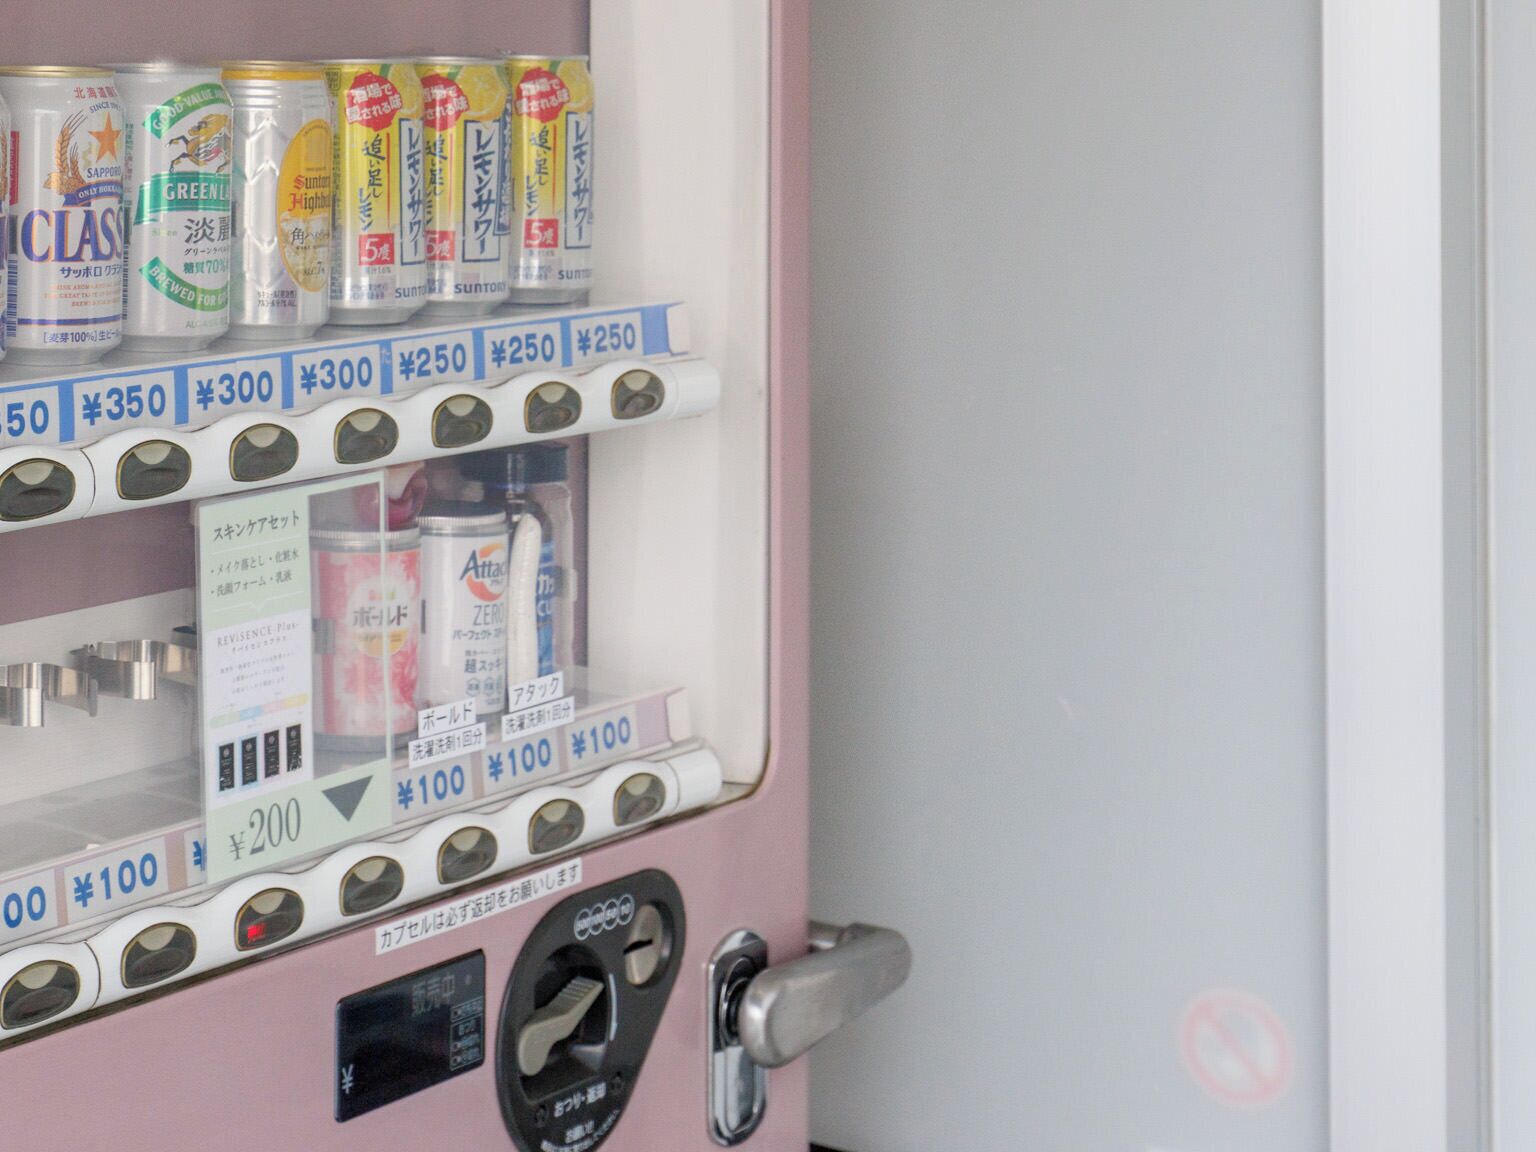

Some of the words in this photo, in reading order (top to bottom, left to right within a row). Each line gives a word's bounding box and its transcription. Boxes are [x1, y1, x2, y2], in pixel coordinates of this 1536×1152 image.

[184, 89, 214, 106] VALUE
[351, 82, 393, 105] 酒場で
[515, 88, 570, 114] 愛される味
[520, 77, 561, 97] 酒場で
[89, 102, 111, 114] SINCE
[345, 94, 403, 123] 愛される味
[362, 134, 386, 199] 追い足し
[426, 134, 448, 197] 追い足し
[531, 125, 551, 186] 追い足し
[78, 187, 97, 198] ONLY
[163, 182, 218, 201] GREEN
[405, 127, 424, 257] レモンサワー
[471, 129, 496, 255] レモンサワー
[525, 175, 538, 217] レモン
[570, 120, 590, 241] レモンサワー
[358, 187, 373, 232] レモン
[360, 238, 391, 262] 5度
[525, 223, 554, 246] 5度
[60, 265, 102, 279] サッポロ
[149, 267, 196, 302] BREWED
[197, 294, 216, 306] FOR
[491, 333, 555, 370] ¥250
[577, 322, 637, 357] ¥250
[300, 355, 373, 396] ¥300
[399, 343, 467, 381] ¥250
[82, 384, 167, 426] ¥350
[196, 370, 274, 411] ¥300
[212, 510, 300, 542] スキンケアセット
[452, 630, 492, 640] パーフェクト
[513, 675, 560, 706] アタック
[422, 701, 473, 732] ボールド
[505, 704, 572, 735] 洗濯洗剤1回分
[412, 728, 484, 761] 洗濯洗剤1回分
[572, 716, 632, 759] ¥100
[488, 738, 552, 782] ¥100
[397, 765, 465, 810] ¥100
[229, 797, 302, 862] ¥200
[73, 852, 159, 909] ¥100
[380, 863, 581, 949] カプセルは必ず返却をお願いします
[341, 1063, 354, 1095] ¥
